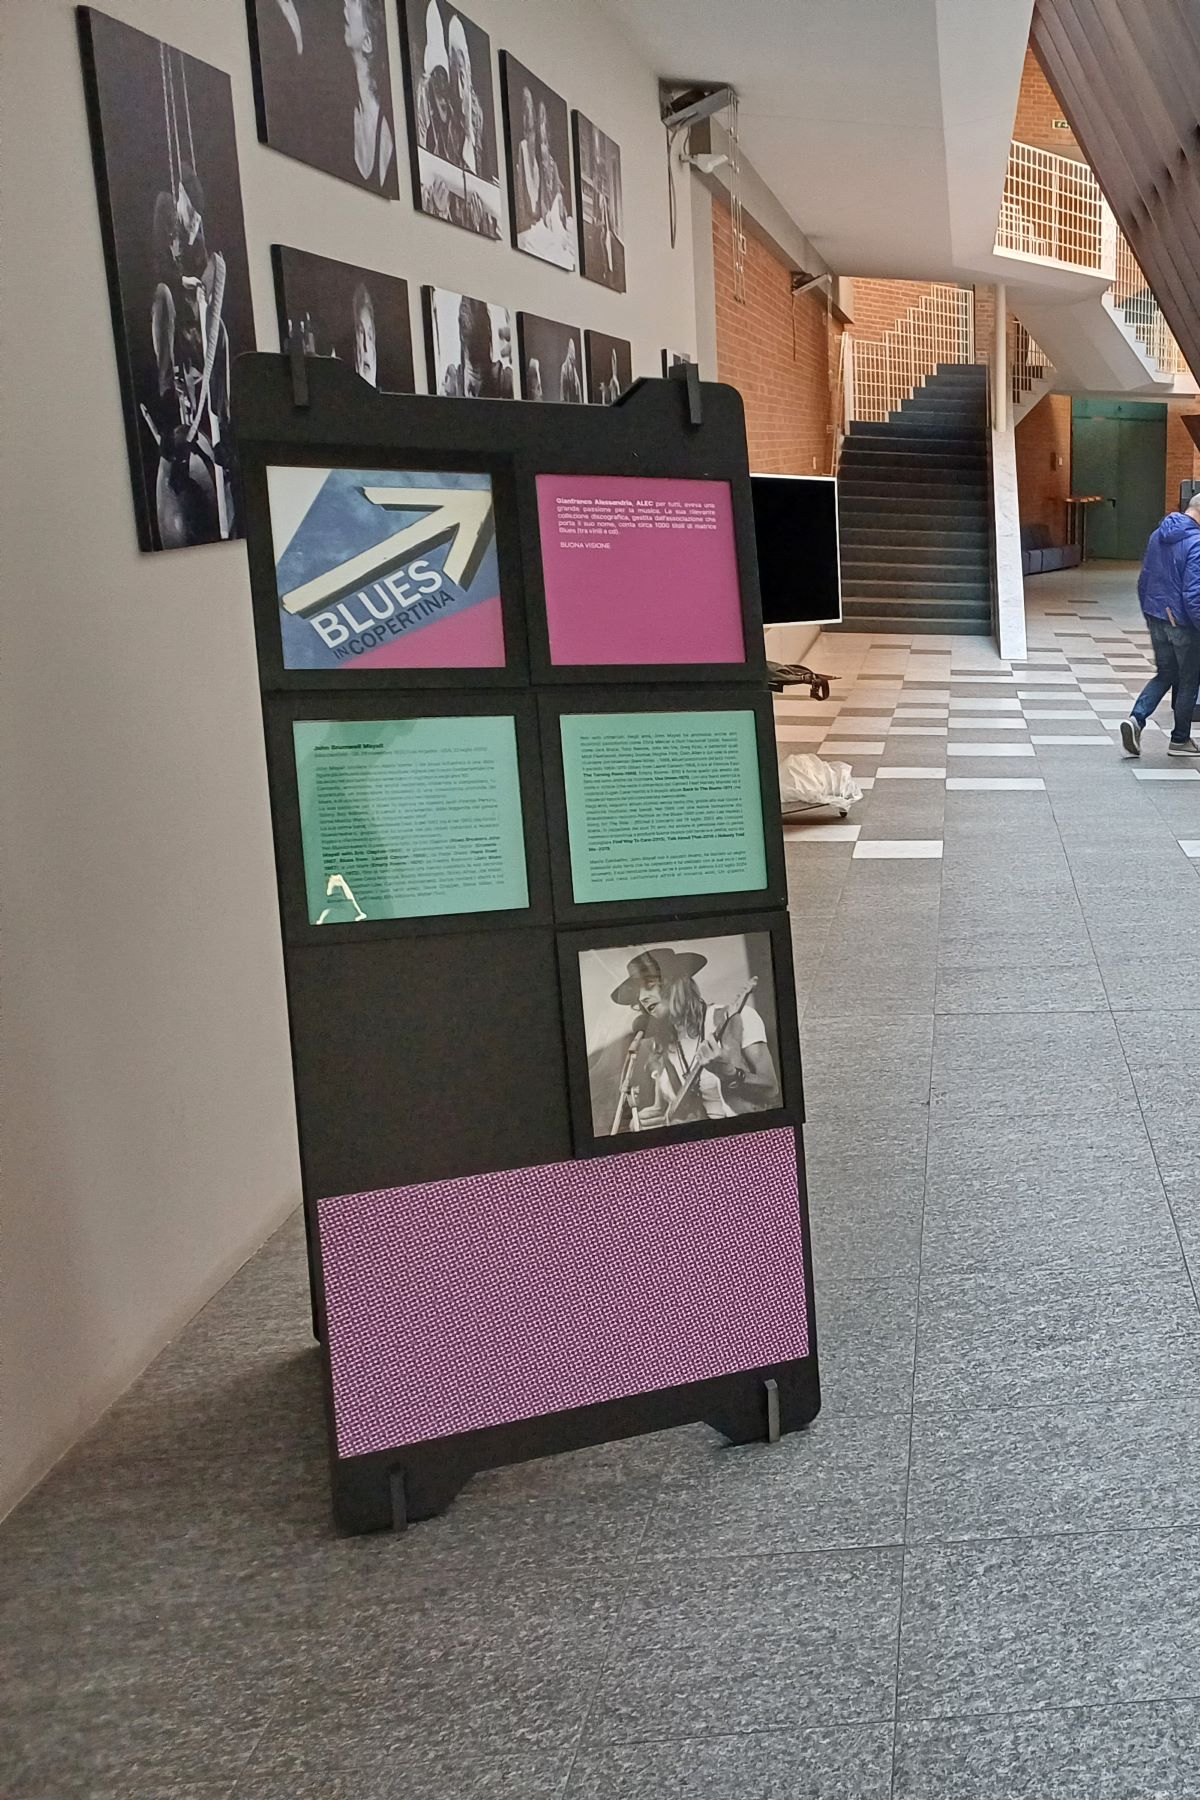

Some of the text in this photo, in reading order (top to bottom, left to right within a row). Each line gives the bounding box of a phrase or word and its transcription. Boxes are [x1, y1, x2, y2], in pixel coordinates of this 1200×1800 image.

[309, 560, 443, 649] BLUES
[333, 590, 455, 660] IN COPERTINA
